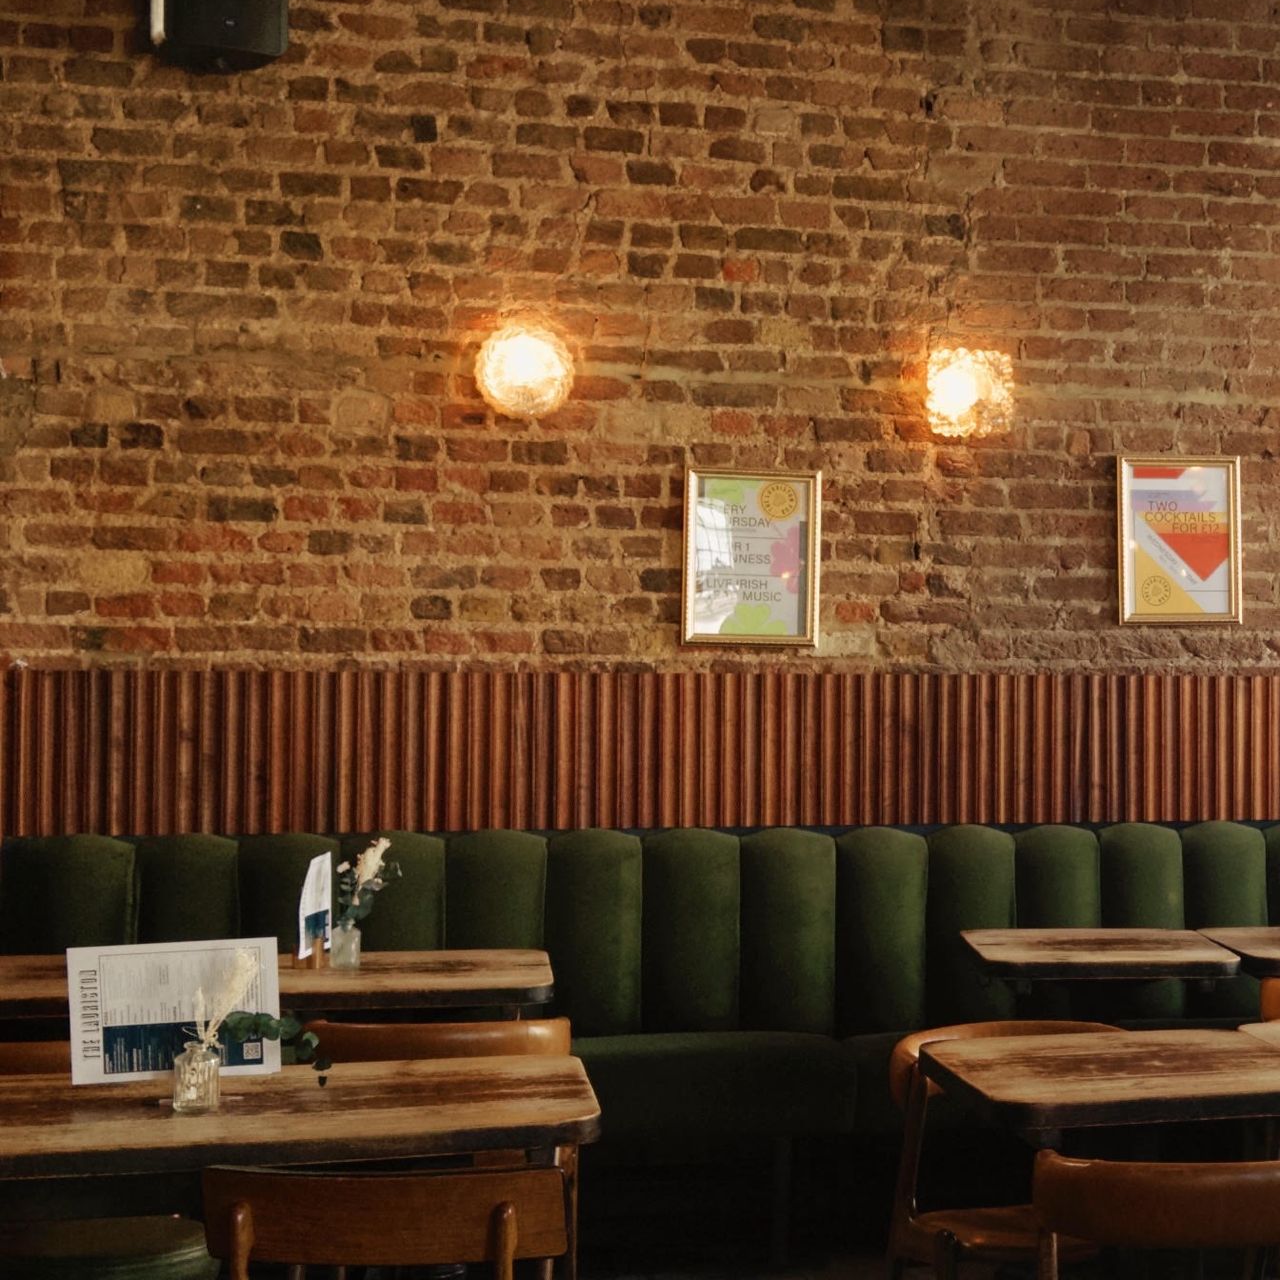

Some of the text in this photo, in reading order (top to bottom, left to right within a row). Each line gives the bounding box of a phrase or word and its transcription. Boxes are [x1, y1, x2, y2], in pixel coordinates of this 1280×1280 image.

[1148, 501, 1178, 512] TWO
[1145, 512, 1216, 523] COCKTAILS
[1172, 523, 1198, 534] FOR
[742, 592, 782, 602] MUSIC
[82, 1039, 101, 1058] THE
